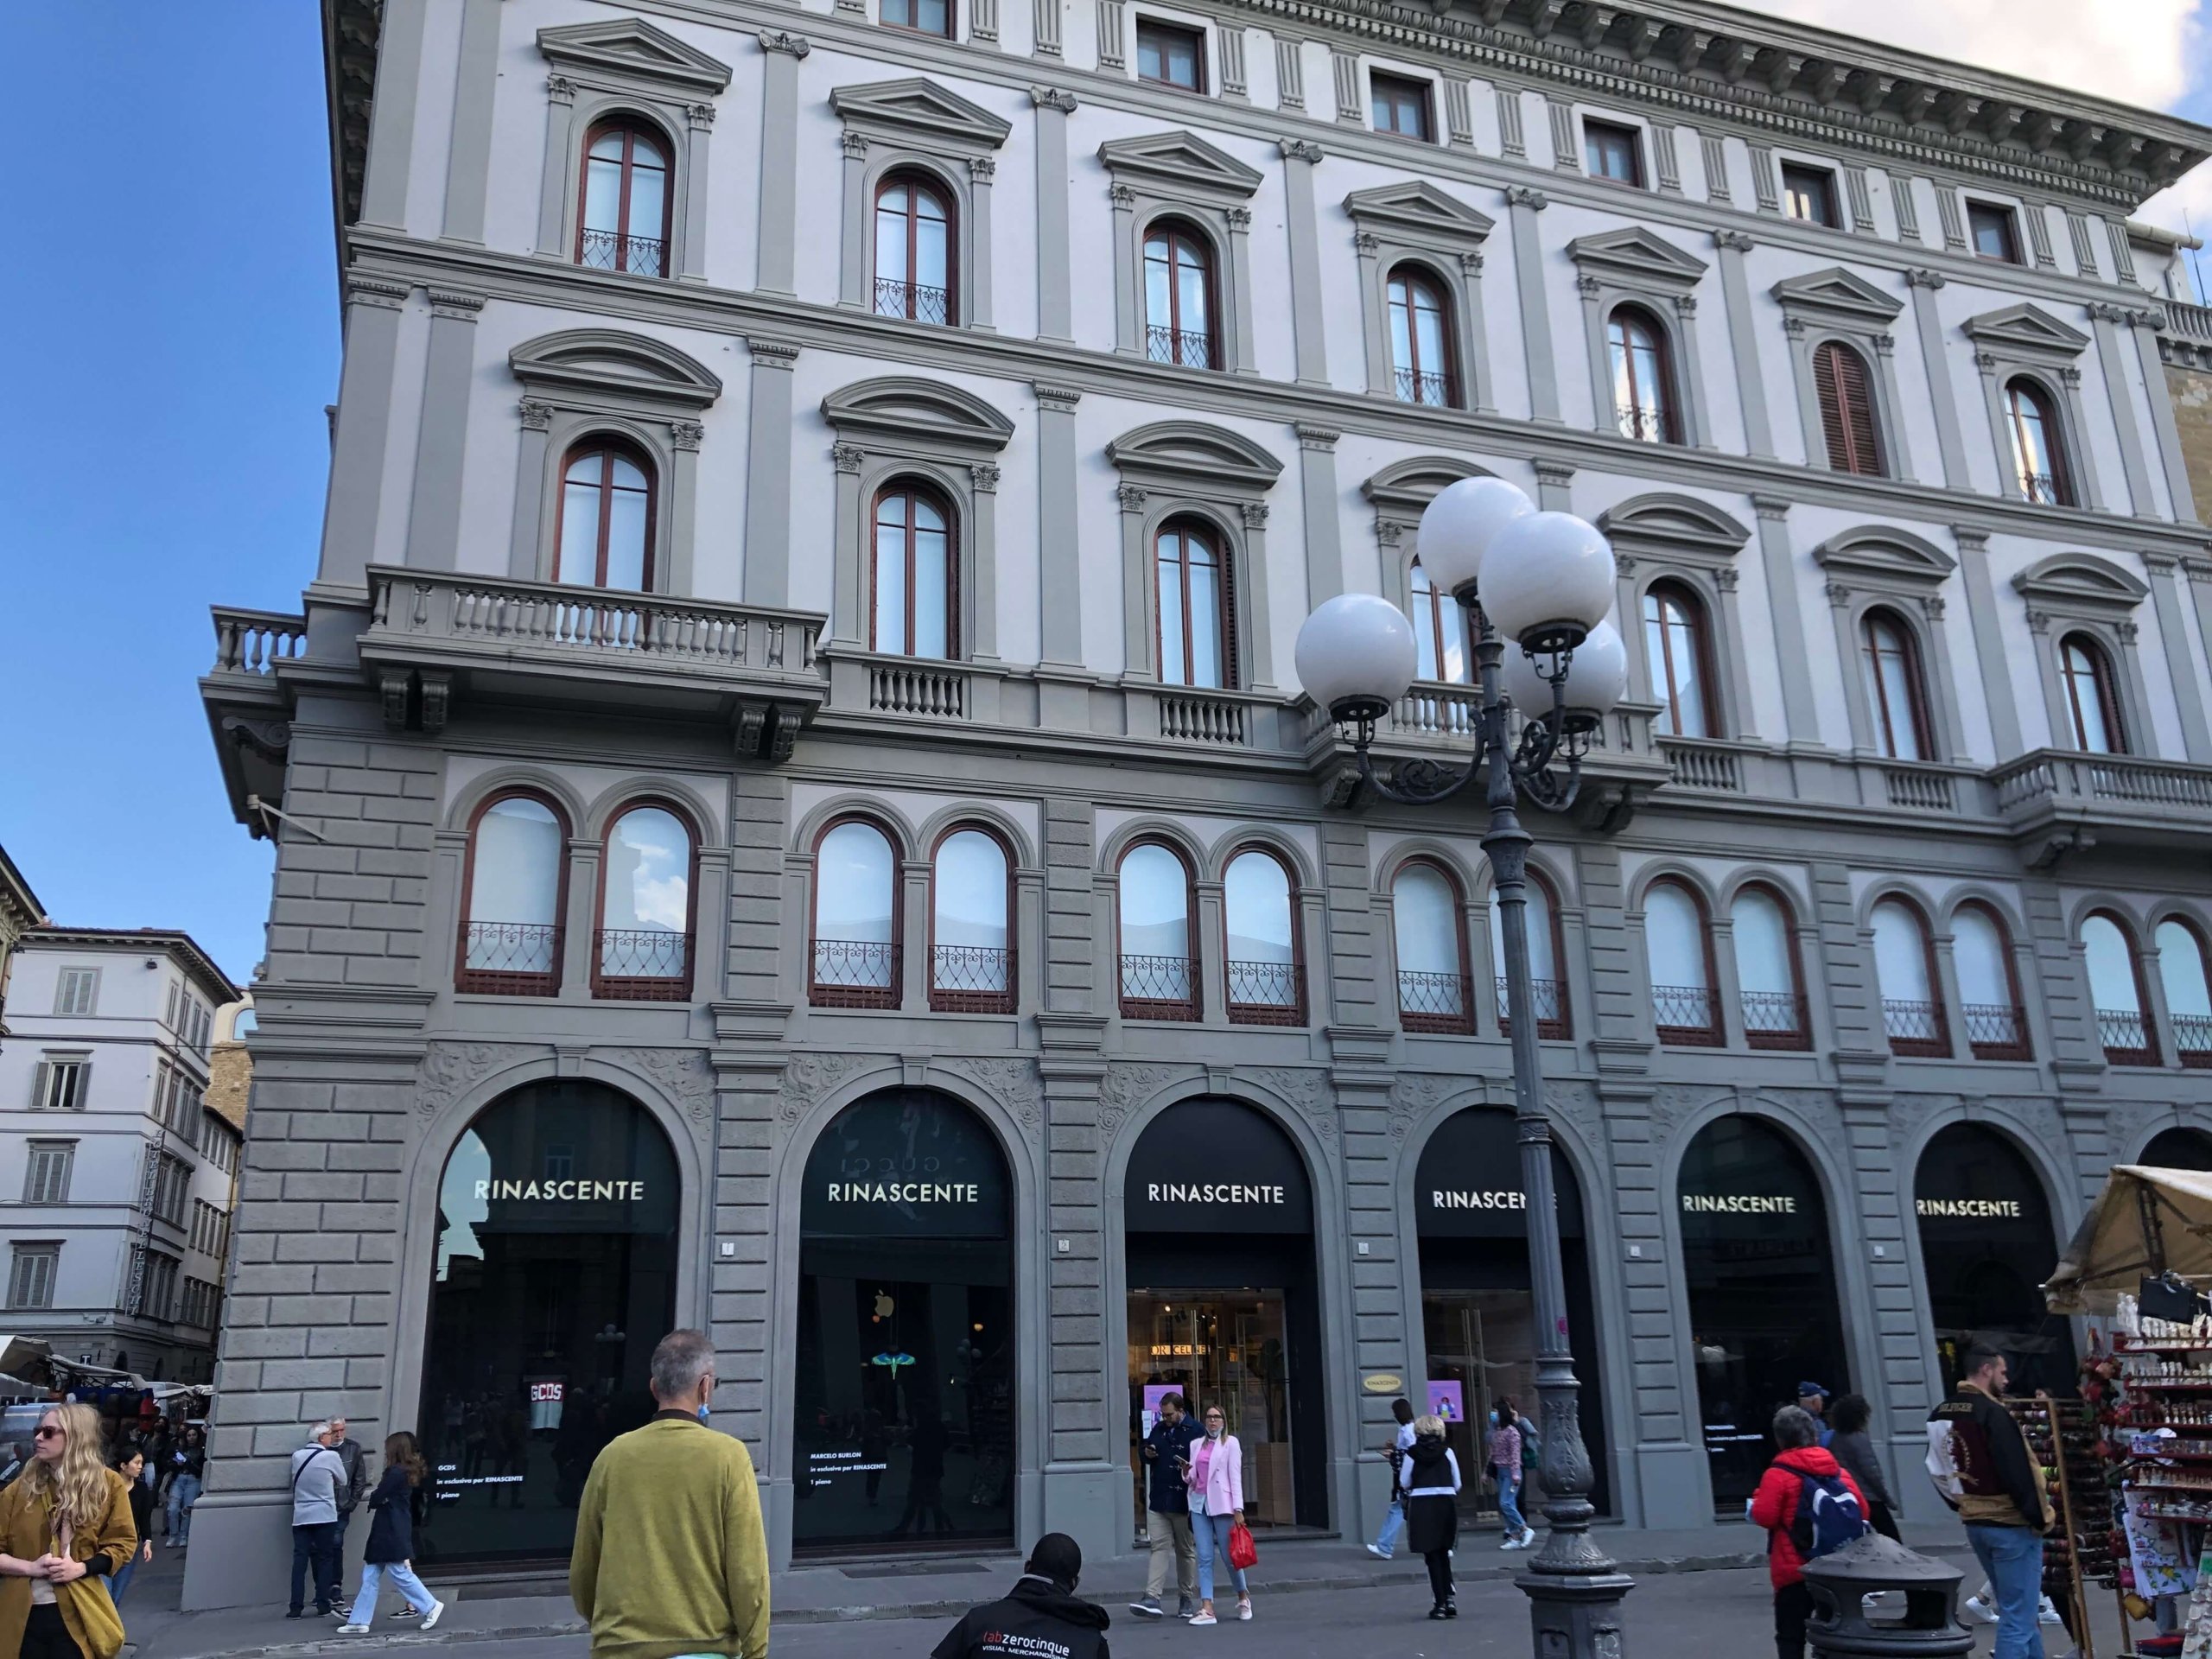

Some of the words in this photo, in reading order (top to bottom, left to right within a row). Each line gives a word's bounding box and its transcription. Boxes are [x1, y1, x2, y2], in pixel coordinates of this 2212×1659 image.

[474, 1180, 645, 1200] RINASCENTE
[828, 1183, 978, 1203] RINASCENTE
[1148, 1184, 1284, 1204] RINASCENTE
[1682, 1195, 1796, 1213] RINASCENTE
[1916, 1199, 2020, 1217] RINASCENTE
[531, 1383, 563, 1401] GCDS
